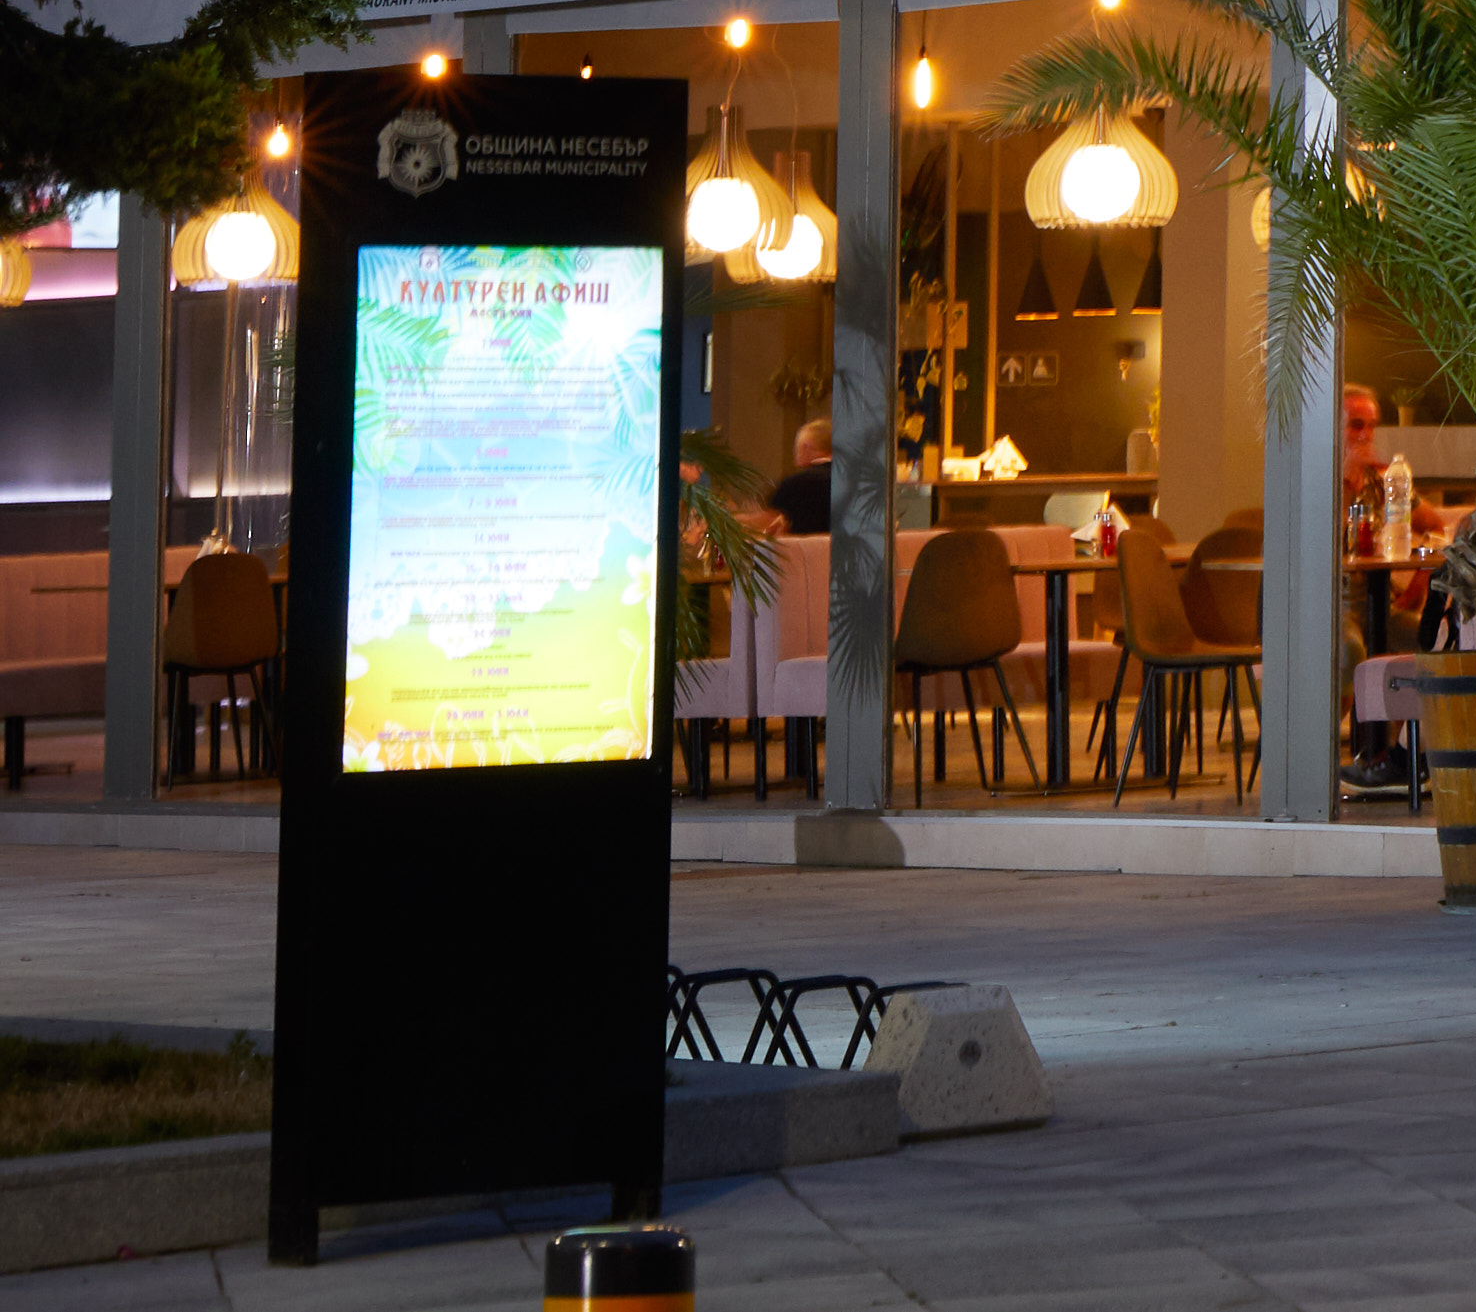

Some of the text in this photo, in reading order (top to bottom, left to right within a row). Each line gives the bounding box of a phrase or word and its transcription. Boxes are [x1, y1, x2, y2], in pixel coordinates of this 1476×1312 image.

[465, 135, 649, 157] ОБЩИНА НЕСЕБЪР
[466, 160, 647, 176] NESSEBAR MUNICIPALITY
[400, 280, 610, 305] КУЛТУРЕН АФИШ
